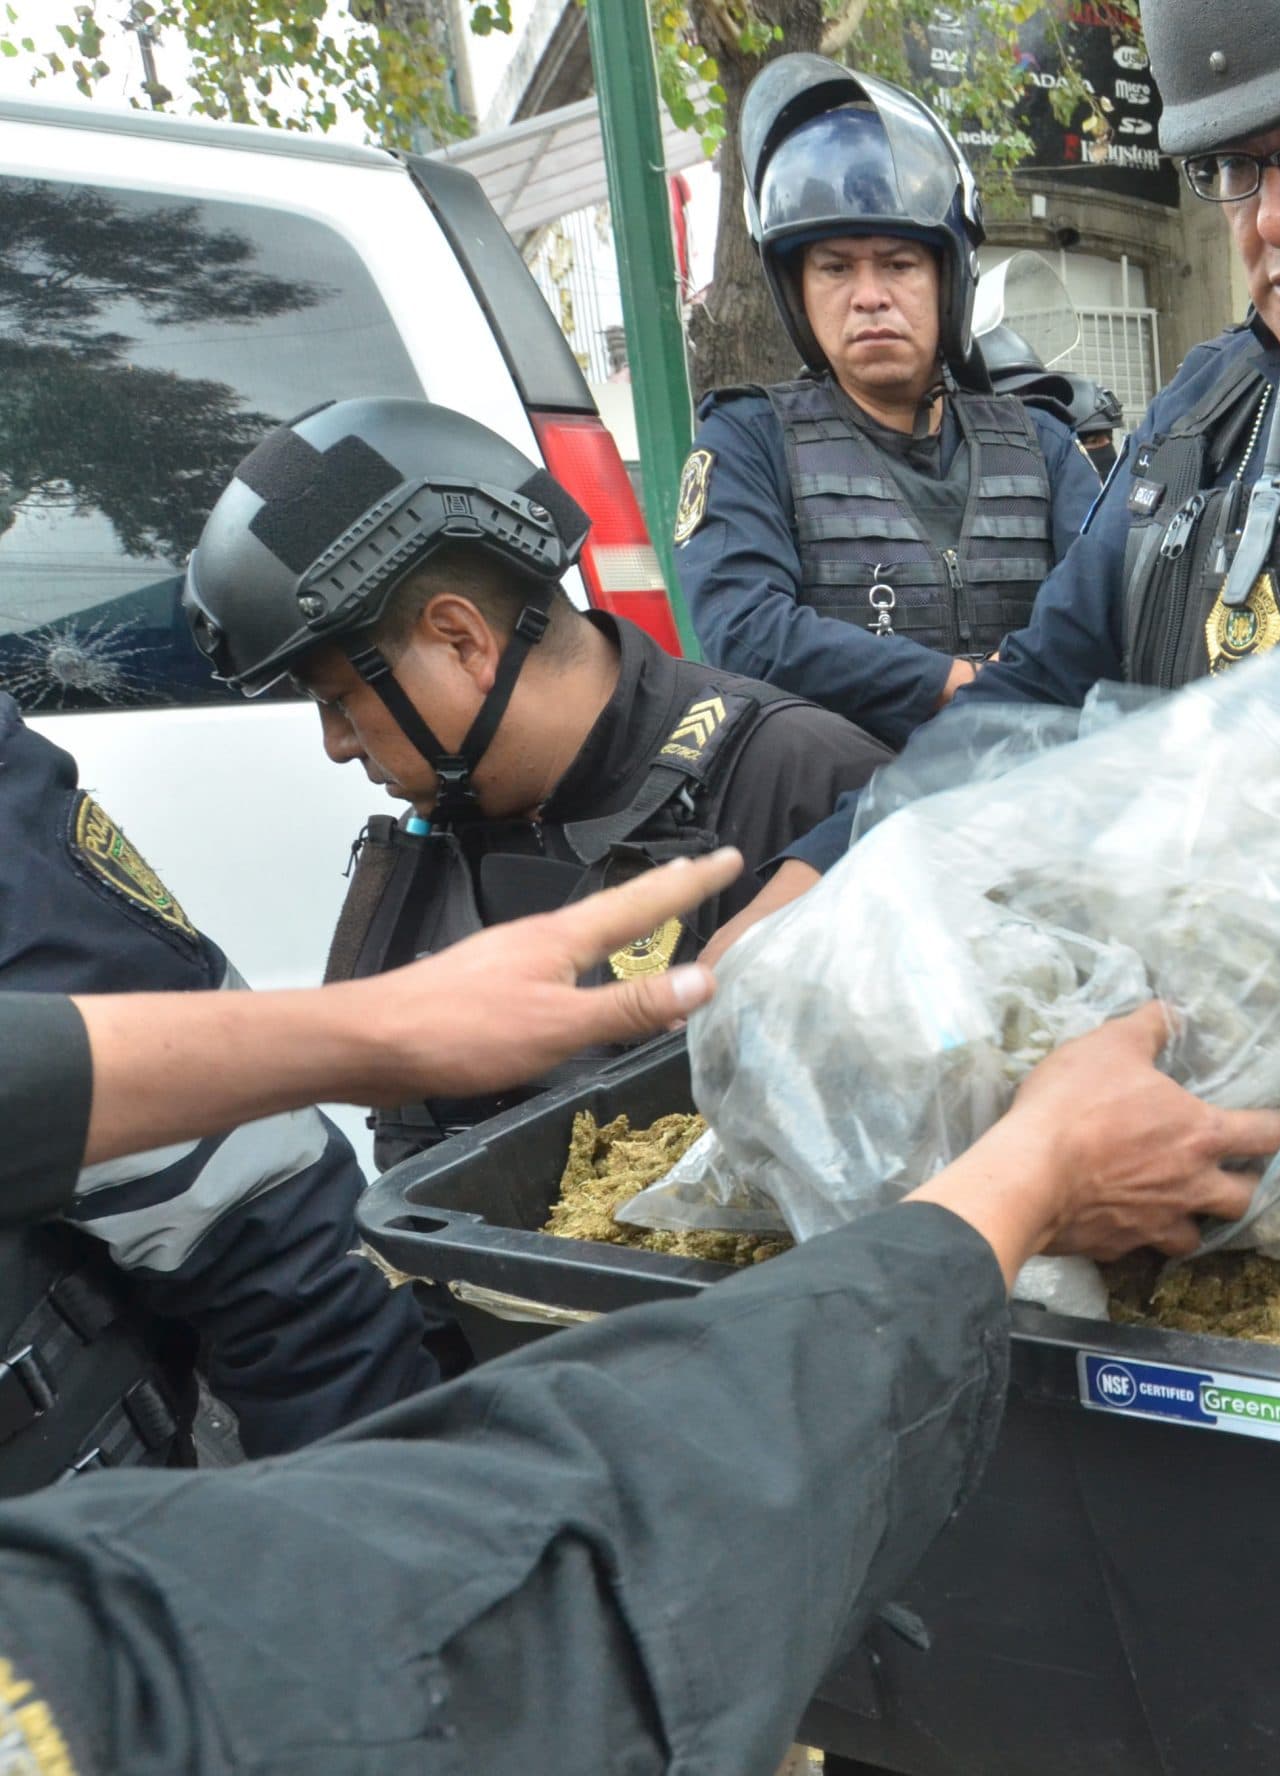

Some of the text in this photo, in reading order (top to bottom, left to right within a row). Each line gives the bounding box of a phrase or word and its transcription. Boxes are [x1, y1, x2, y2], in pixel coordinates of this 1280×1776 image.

[931, 47, 967, 64] DV
[1029, 72, 1095, 94] ADAA
[1081, 139, 1160, 168] Kngston
[1101, 1373, 1131, 1396] NSF
[1139, 1381, 1195, 1403] CERTIFIED
